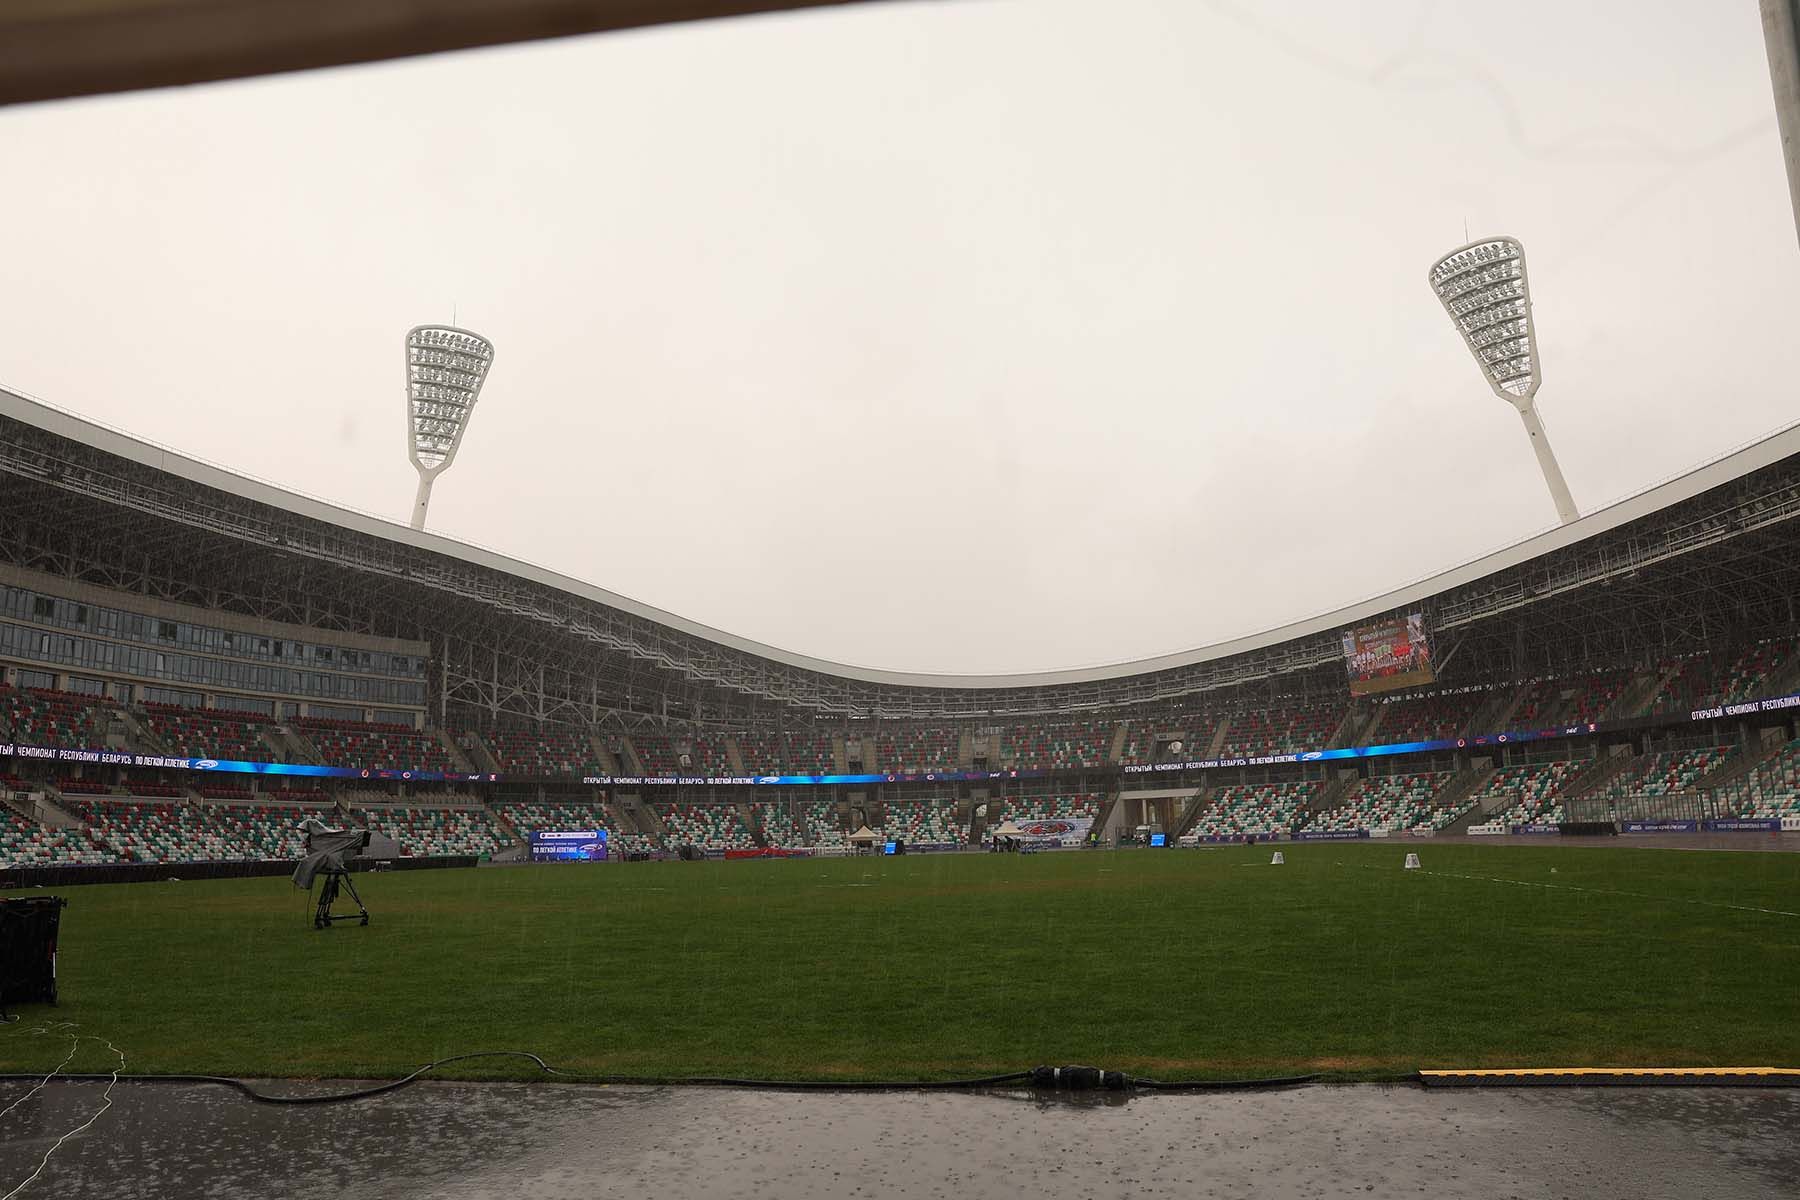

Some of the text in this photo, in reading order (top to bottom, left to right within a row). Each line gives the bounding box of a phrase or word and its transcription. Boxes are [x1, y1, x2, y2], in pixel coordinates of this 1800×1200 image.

[1691, 706, 1723, 720] ОТКРЫТЫЙ
[1725, 702, 1759, 715] ЧЕМПИОНАТ
[17, 746, 57, 759] ЧЕМПИОНАТ
[59, 750, 99, 762] РЕСПУБЛИКИ
[101, 753, 132, 764] БЕЛАРУСЬ
[135, 756, 143, 765] ПО
[144, 756, 164, 766] ЛЕГКОЙ
[164, 758, 190, 768] АТЛЕТИКЕ
[1124, 763, 1153, 773] ОТКРЫТЫЙ
[1155, 762, 1184, 771] ЧЕМПИОНАТ
[1186, 760, 1218, 769] РЕСПУБЛИКИ
[1220, 759, 1246, 767] БЕЛАРУСЬ
[583, 776, 611, 784] ОТКРЫТЫЙ
